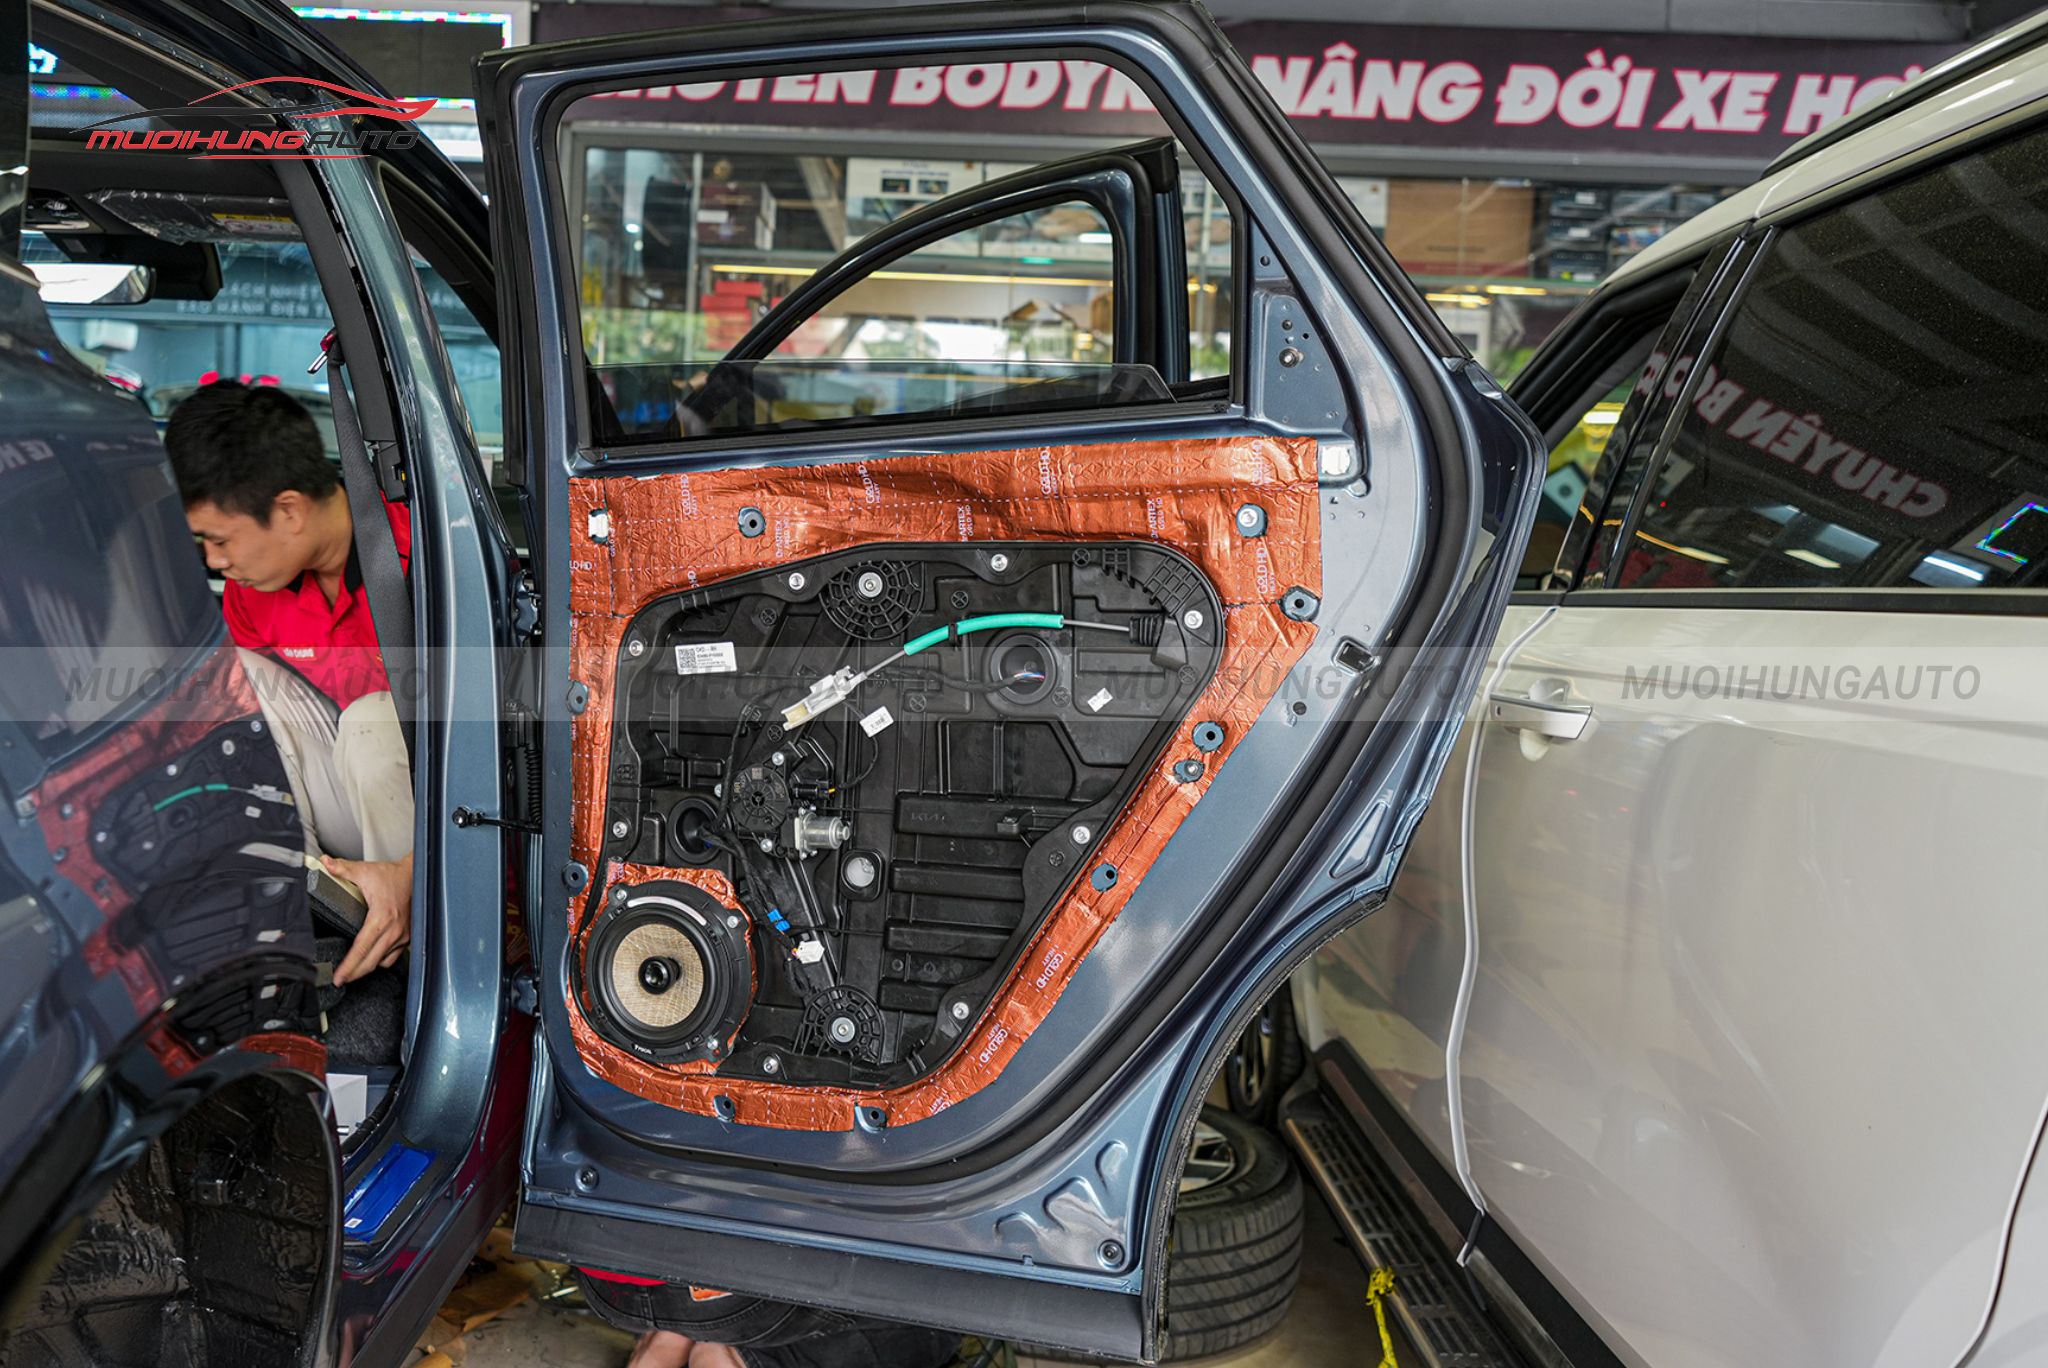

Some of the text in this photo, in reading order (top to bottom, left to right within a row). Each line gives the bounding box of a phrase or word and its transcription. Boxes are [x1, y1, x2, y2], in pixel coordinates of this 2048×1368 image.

[1249, 42, 1484, 125] NÂNG
[1494, 48, 1657, 130] ĐỜI
[1656, 68, 1783, 134] XE
[863, 477, 874, 504] GOLD
[1256, 547, 1268, 595] GOLD HD
[1037, 953, 1064, 989] GOLD HD
[980, 1028, 1009, 1063] GOLD HD
